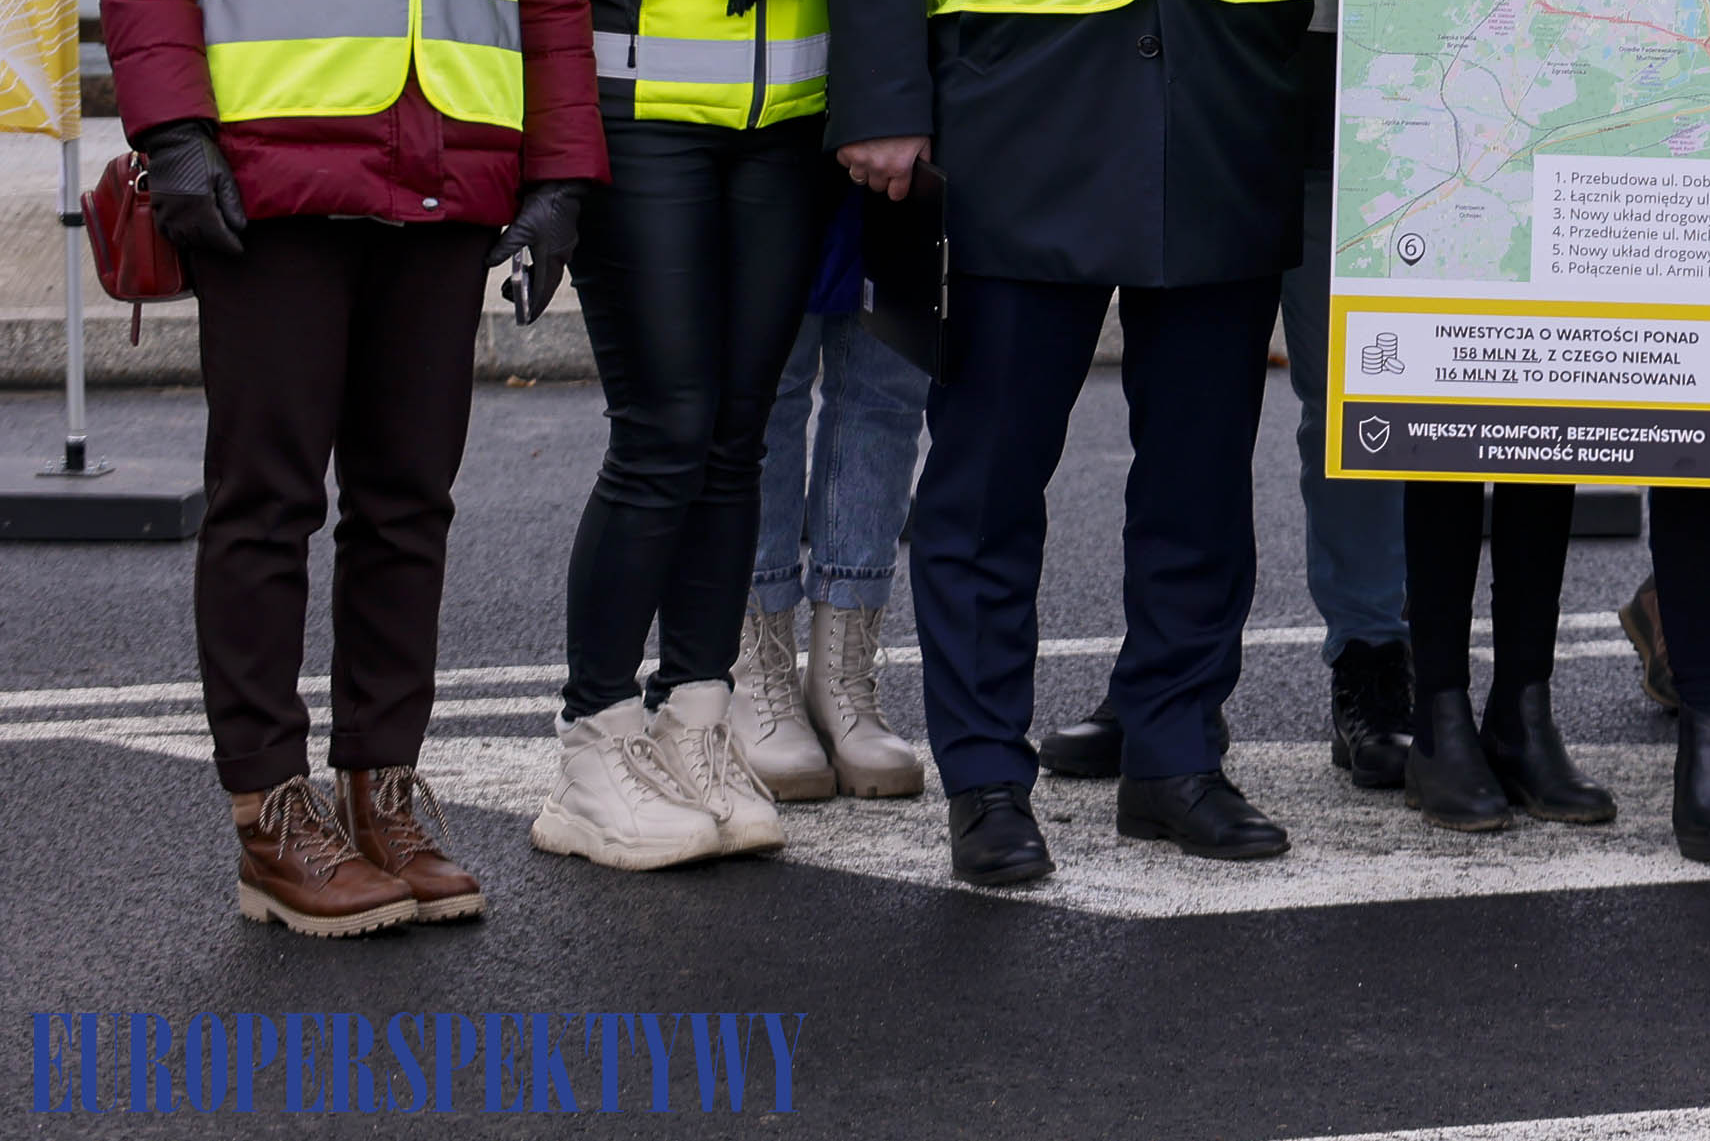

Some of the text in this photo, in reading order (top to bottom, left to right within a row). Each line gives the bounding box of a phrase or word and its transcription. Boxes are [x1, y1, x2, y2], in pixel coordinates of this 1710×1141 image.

[1555, 171, 1567, 184] 1.
[1571, 171, 1658, 187] Przebudowa
[1661, 173, 1678, 187] ul.
[1553, 188, 1566, 202] 2.
[1570, 189, 1621, 205] Łącznik
[1625, 191, 1694, 209] pomiędzy
[1552, 207, 1566, 220] 3.
[1570, 207, 1610, 224] Nowy
[1613, 208, 1652, 222] układ
[1552, 225, 1565, 237] 4.
[1569, 225, 1659, 240] Przedłużenie
[1662, 227, 1679, 241] ul.
[1405, 238, 1417, 256] 6
[1552, 243, 1564, 256] 5.
[1569, 243, 1609, 261] Nowy
[1612, 244, 1650, 258] układ
[1551, 261, 1564, 274] 6.
[1568, 261, 1642, 278] Połączenie
[1646, 263, 1663, 277] ul.
[1666, 264, 1704, 278] Armii
[1435, 325, 1700, 345] INWESTYCJA O WARTOŚCI PONAD
[1453, 347, 1680, 364] 158 MLN ZŁ, Z CZEGO NIEMAL
[1435, 368, 1697, 386] 116 MLN ZŁ TO DOFINANSOWANIA
[1407, 422, 1706, 444] WIĘKSZY KOMFORT, BEZPIECZEŃSTWO
[1478, 443, 1634, 463] I PŁYNNOŚĆ RUCHU
